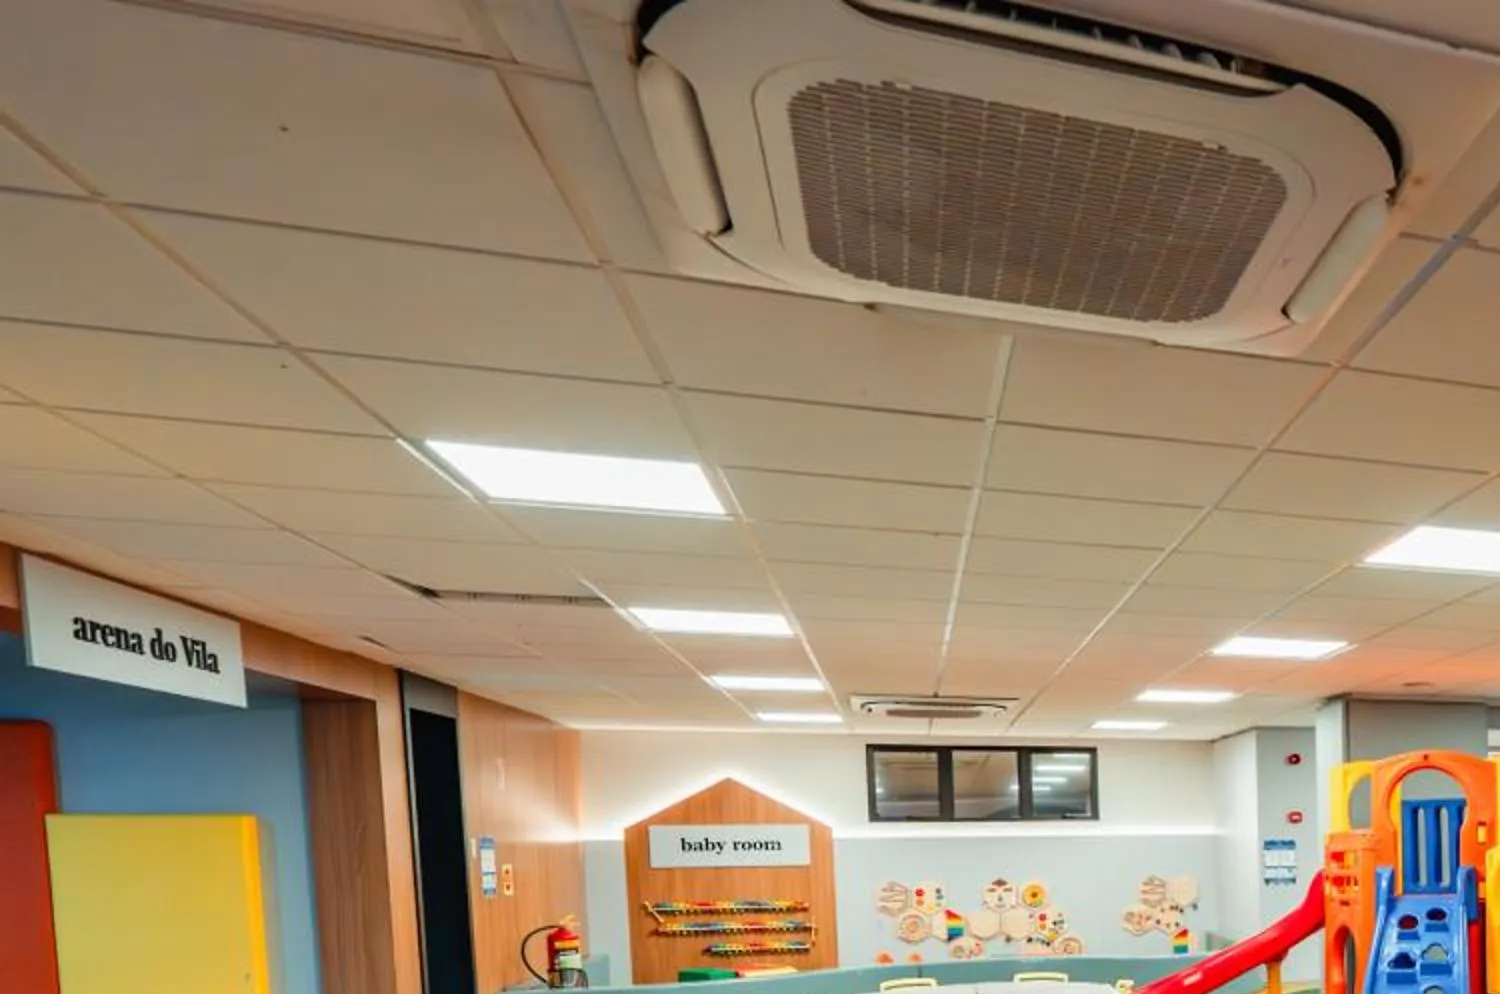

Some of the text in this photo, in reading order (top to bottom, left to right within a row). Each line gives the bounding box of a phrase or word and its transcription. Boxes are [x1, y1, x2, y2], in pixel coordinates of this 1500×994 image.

[72, 616, 220, 674] arena do Vila
[681, 837, 782, 855] baby room
